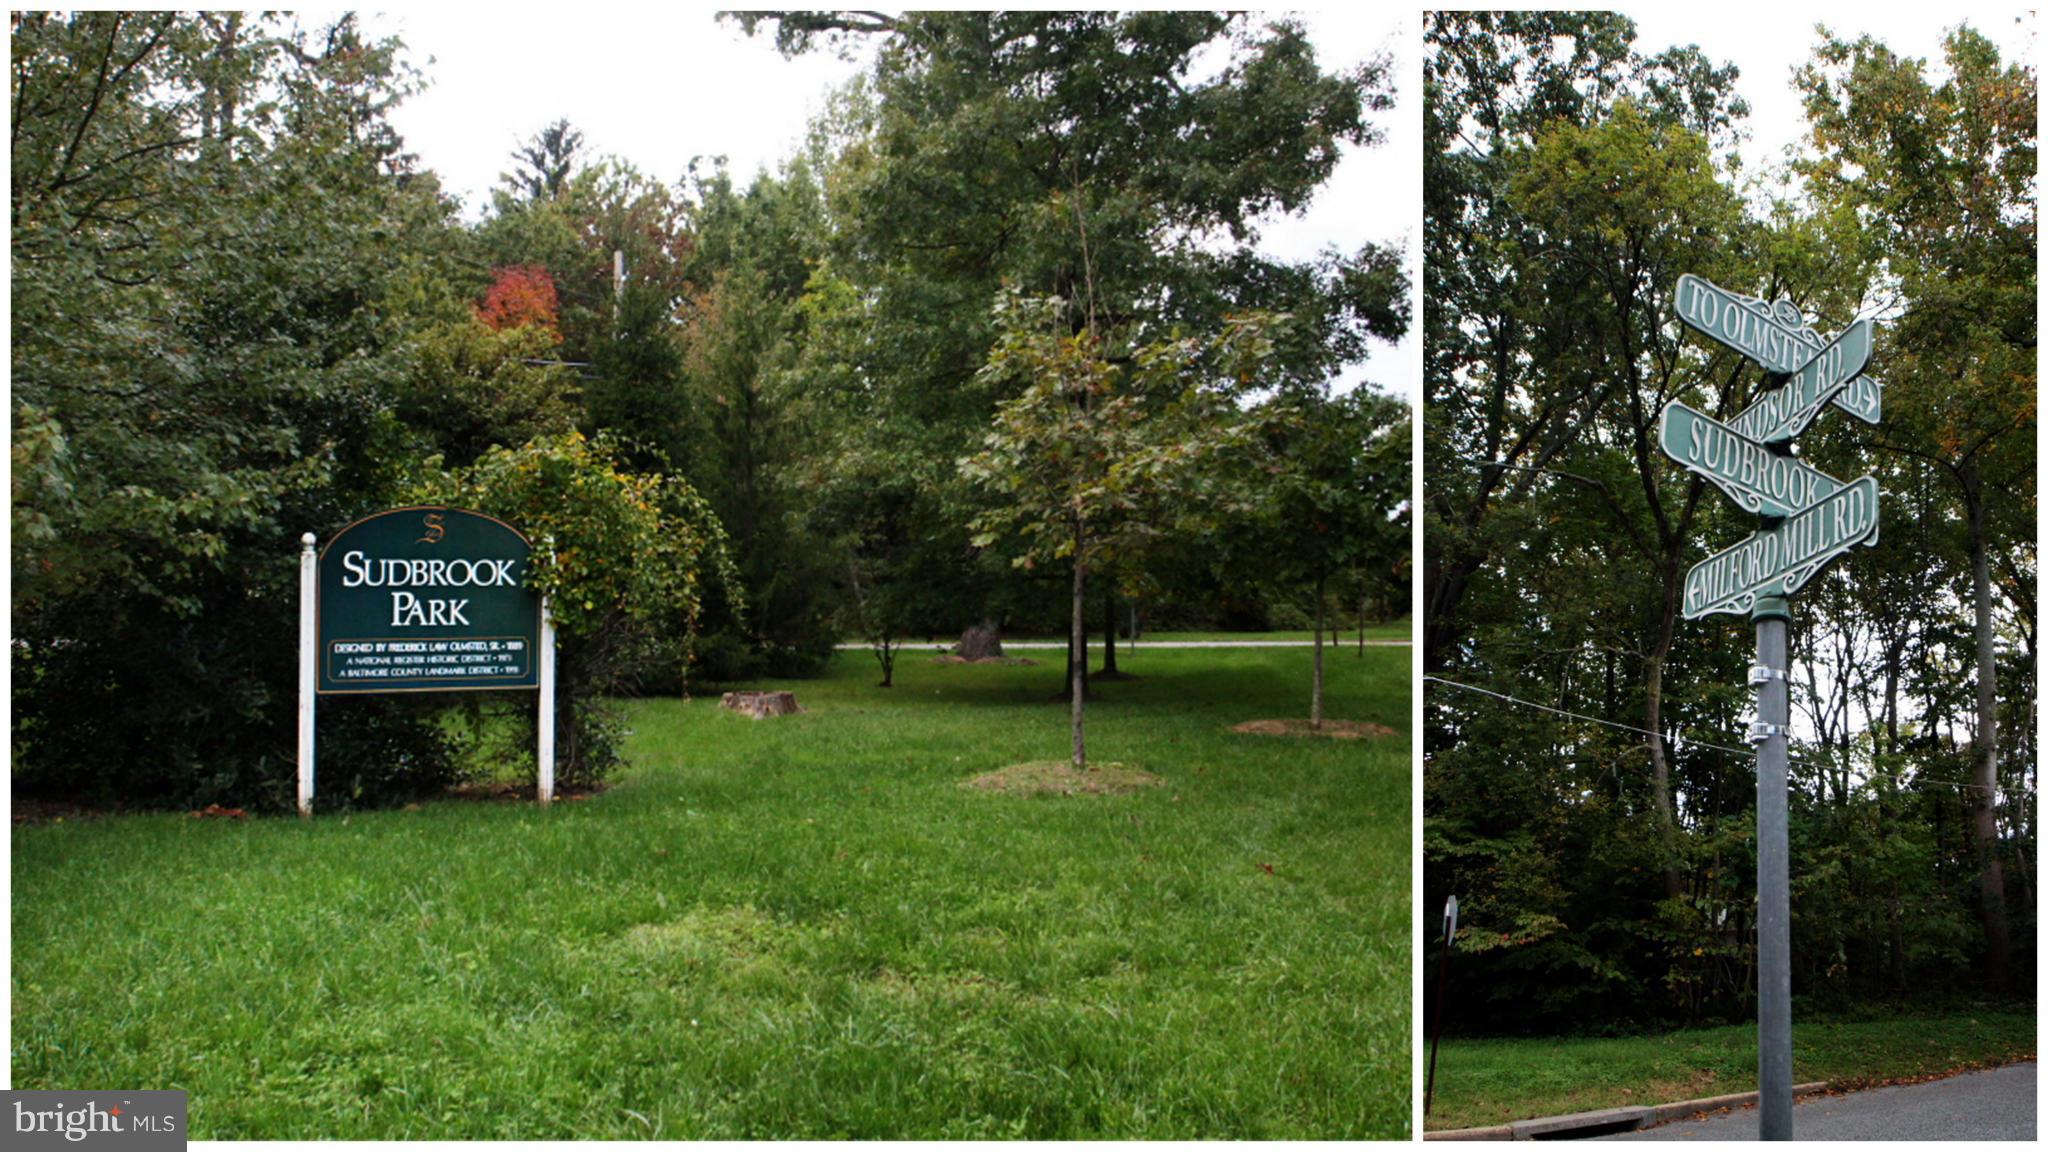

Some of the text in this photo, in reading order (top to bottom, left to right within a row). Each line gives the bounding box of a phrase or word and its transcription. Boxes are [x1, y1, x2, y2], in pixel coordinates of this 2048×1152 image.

[1687, 280, 1718, 328] TO
[1815, 343, 1845, 397] RD.
[1689, 417, 1821, 507] SUDBROOK
[1697, 486, 1867, 608] MILFORD MILL RD.
[343, 551, 517, 587] SUDBROOK
[391, 592, 470, 627] PARK
[376, 643, 387, 653] BY
[429, 642, 449, 652] LAW
[427, 654, 459, 663] HISTORIC
[461, 654, 492, 663] DISTRICT
[339, 669, 346, 677] A
[348, 668, 388, 677] BALTIMORE
[390, 667, 423, 676] COUNTY
[425, 667, 466, 676] LANDMARK
[468, 666, 499, 675] DISTRICT
